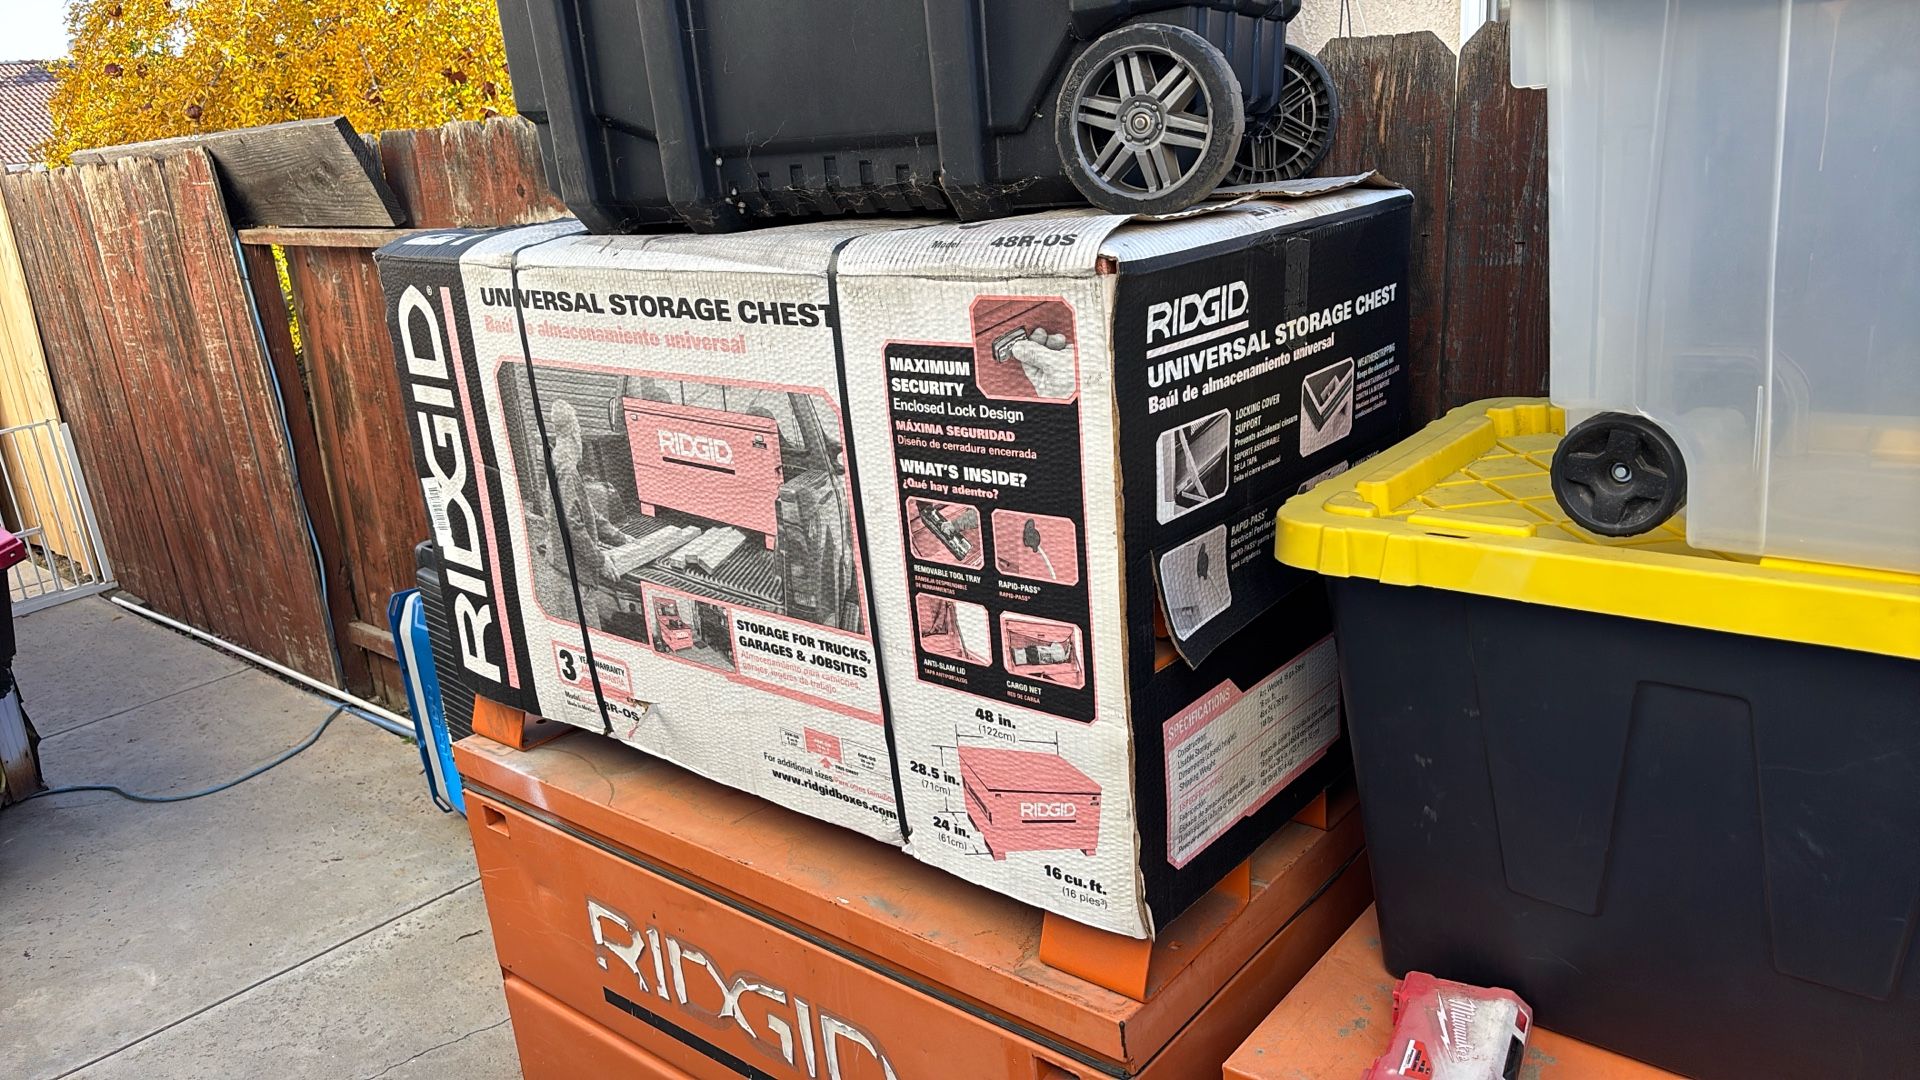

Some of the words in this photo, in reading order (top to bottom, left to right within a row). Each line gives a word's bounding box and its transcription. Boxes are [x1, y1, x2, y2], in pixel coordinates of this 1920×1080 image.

[931, 239, 961, 249] Model
[990, 233, 1078, 248] 48R-OS
[480, 287, 605, 315] UNVERSAL
[608, 293, 732, 322] STORAGE
[738, 300, 836, 328] CHEST
[1146, 280, 1249, 344] RIDGID
[484, 314, 514, 334] Baúl
[537, 319, 660, 347] almacenamiento
[664, 330, 747, 354] universal
[1147, 331, 1271, 388] UNIVERSAL
[1275, 300, 1352, 345] STORAGE
[1355, 283, 1398, 317] CHEST
[889, 356, 971, 377] MAXIMUM
[1148, 386, 1179, 414] Baúl
[1182, 381, 1199, 402] de
[1201, 352, 1291, 396] almacenamiento
[1293, 332, 1335, 361] universal
[891, 378, 965, 397] SECURITY
[893, 398, 945, 415] Enclosed
[946, 401, 977, 418] Lock
[979, 405, 1025, 424] Design
[1235, 401, 1261, 421] LOCKING
[1261, 393, 1281, 408] COVER
[895, 418, 945, 436] MÁXIMA
[946, 425, 1016, 443] SEGURIDAD
[1234, 415, 1262, 436] SUPPORT
[1234, 433, 1256, 448] Prevents
[1256, 422, 1281, 439] accidental
[656, 430, 735, 465] RIDGID
[897, 434, 928, 448] Diseño
[929, 438, 941, 449] de
[942, 440, 987, 454] cerradura
[988, 444, 1037, 460] encerrada
[1233, 447, 1254, 462] SOPORTE
[900, 458, 959, 476] WHAT'S
[963, 466, 1029, 488] INSIDE?
[902, 476, 928, 490] ¿Qué
[930, 480, 948, 495] hay
[951, 483, 1000, 500] adentro?
[913, 564, 948, 580] REMOVABLE
[949, 570, 965, 582] TOOL
[964, 572, 981, 584] TRAY
[736, 619, 790, 642] STORAGE
[792, 634, 816, 649] FOR
[817, 639, 872, 664] TRUCKS,
[559, 649, 577, 681] 3
[594, 660, 625, 676] WARRANTY
[739, 635, 794, 659] GARAGES
[796, 650, 806, 662] &
[809, 653, 868, 678] JOBSITES
[923, 658, 956, 673] ANTI-SLAM
[956, 666, 966, 676] LID
[1006, 680, 1029, 693] CARGO
[1029, 684, 1042, 695] NET
[975, 707, 994, 723] 48
[998, 713, 1017, 729] in.
[1167, 687, 1232, 741] SPECIFICATIONS
[978, 724, 1016, 743] (122cm)
[763, 752, 776, 763] For
[777, 756, 813, 776] additional
[910, 761, 940, 780] 28.5
[943, 771, 961, 786] in.
[772, 768, 898, 820] www.ridgidboxes.com
[921, 779, 951, 796] (71cm)
[1020, 802, 1077, 818] RIDGID
[933, 816, 951, 832] 24
[954, 824, 971, 839] in.
[938, 832, 968, 850] (61cm)
[1044, 865, 1062, 881] 16
[1064, 874, 1088, 889] cu.
[1089, 880, 1108, 895] ft.
[1062, 887, 1077, 900] (16
[586, 899, 900, 1080] RIDGID
